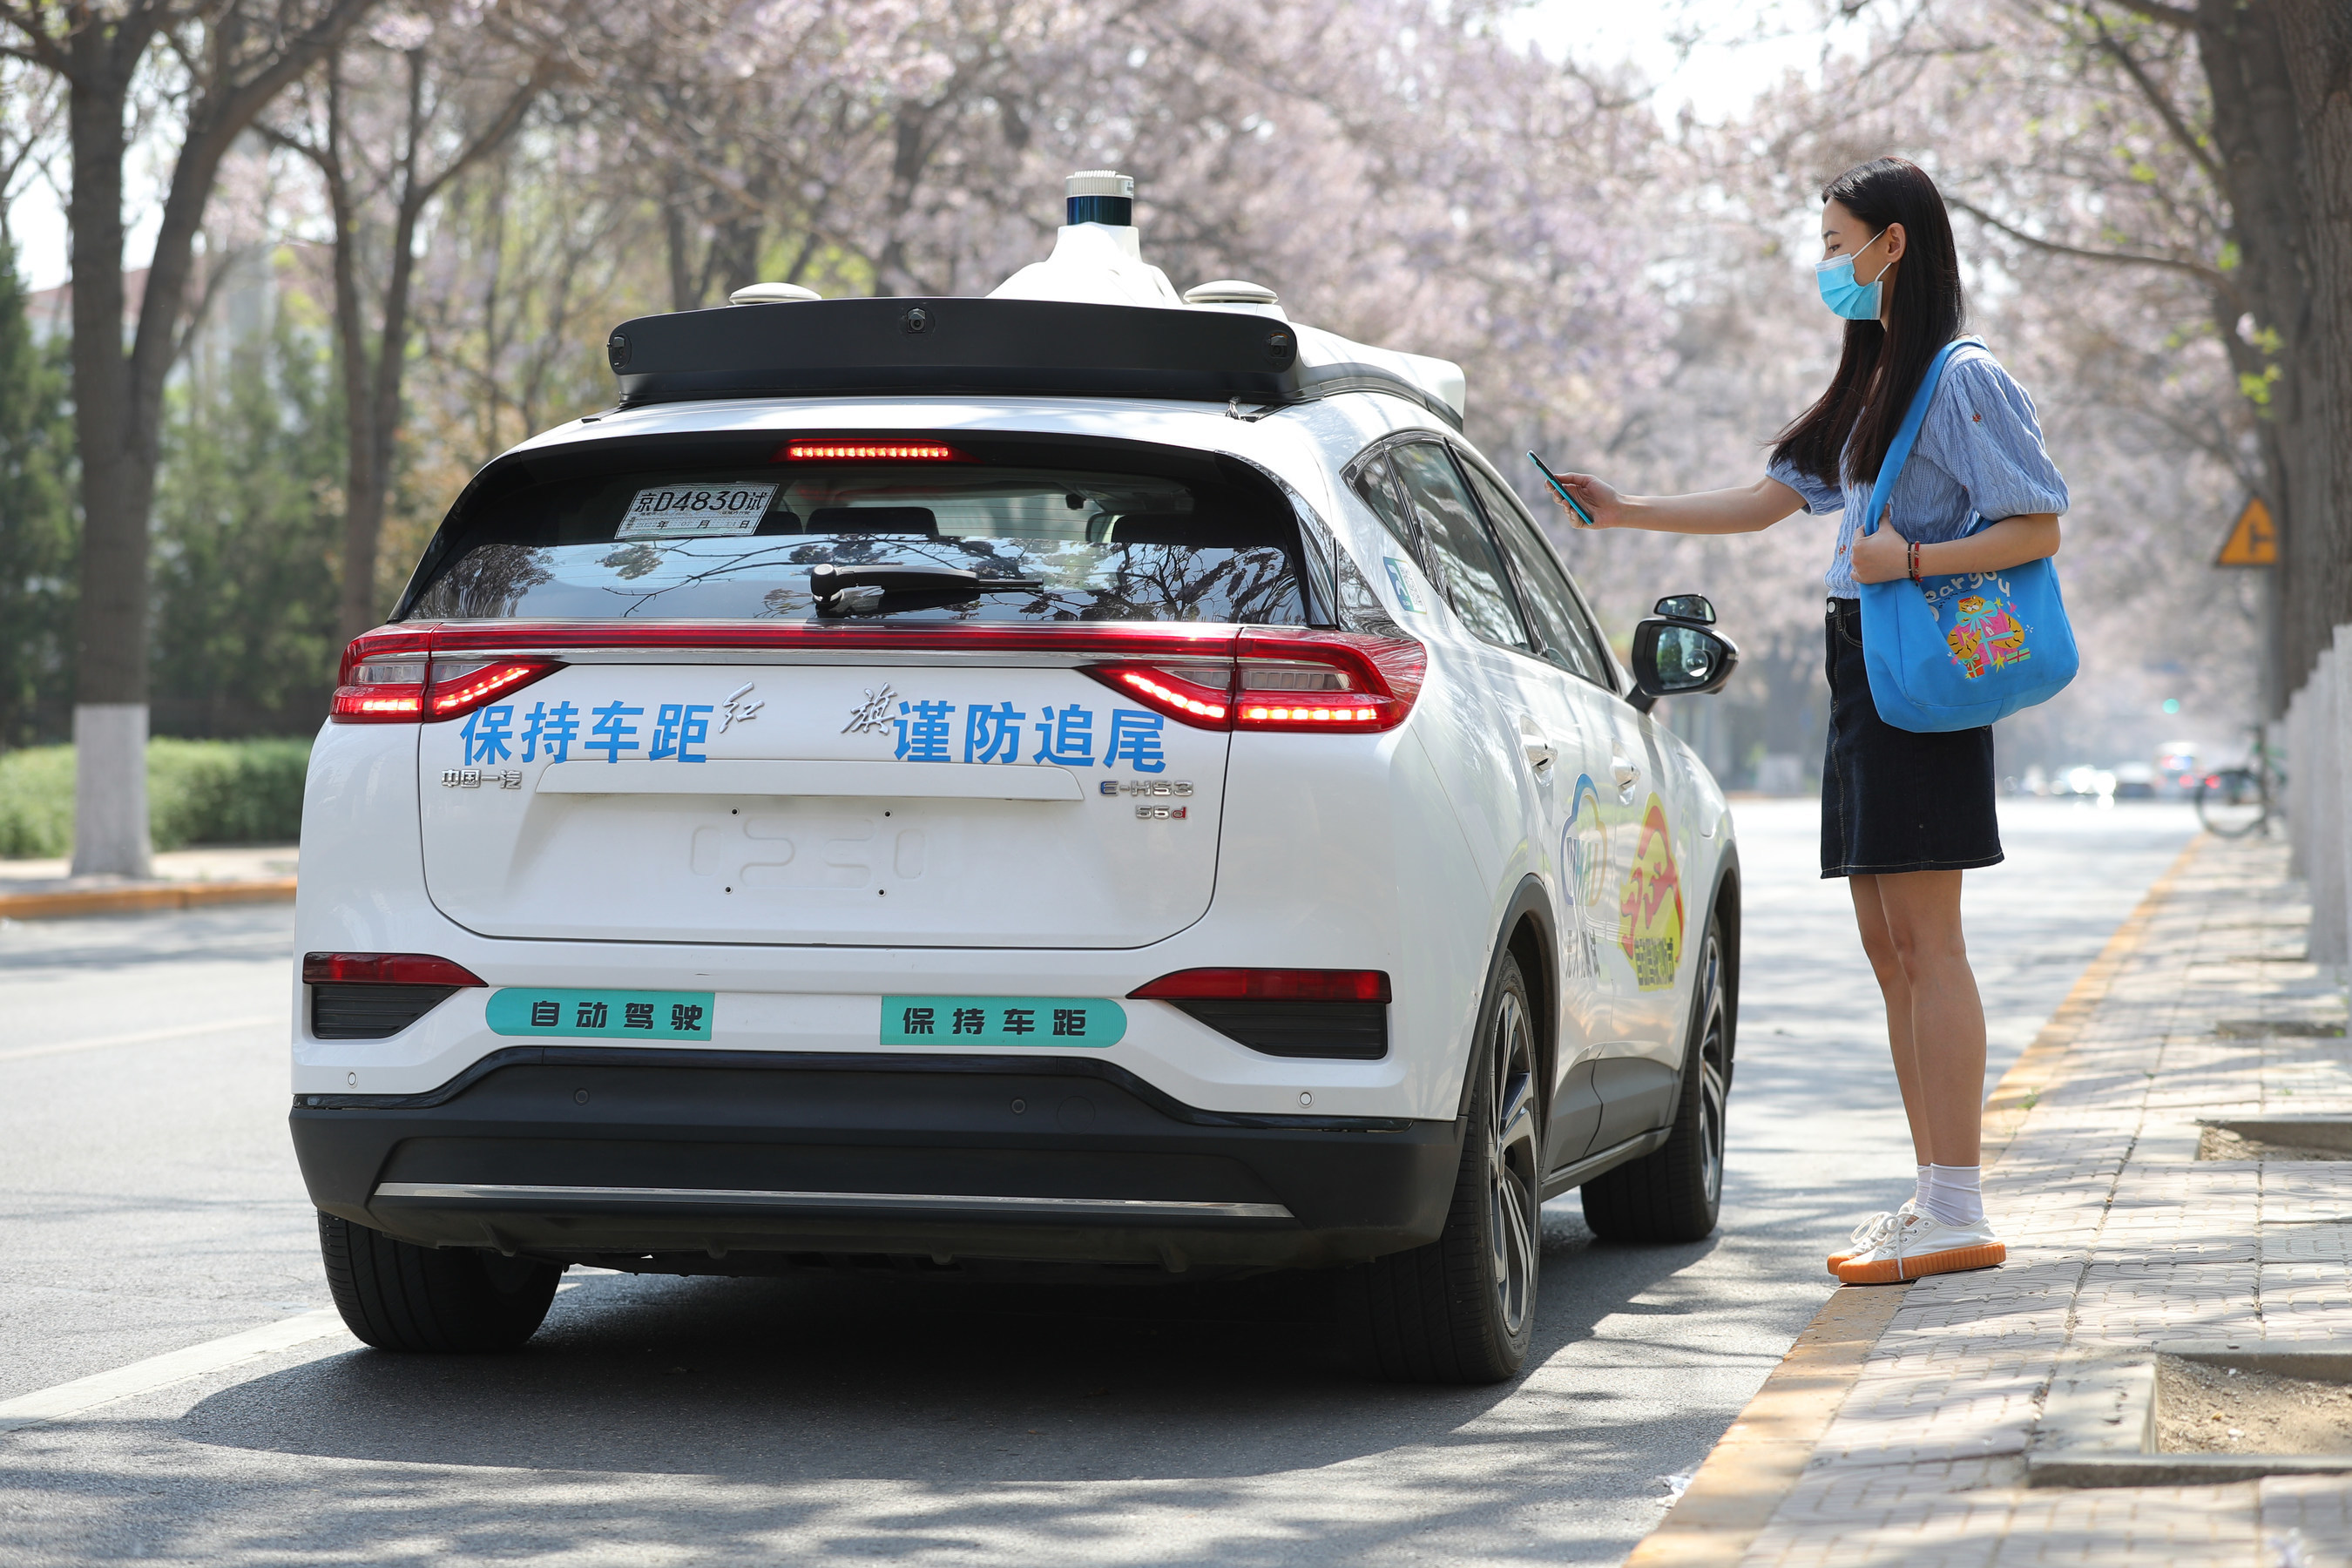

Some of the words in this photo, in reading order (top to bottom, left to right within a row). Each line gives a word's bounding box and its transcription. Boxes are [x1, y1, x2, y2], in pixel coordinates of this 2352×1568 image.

[634, 491, 767, 512] 京D4830试
[657, 521, 669, 530] 年
[697, 520, 710, 529] 月
[460, 700, 713, 766] 保持车距
[893, 700, 1166, 774] 谨防追尾
[442, 769, 522, 789] 中国一汽
[1099, 780, 1193, 796] E-HS3
[1135, 806, 1186, 820] 55d
[531, 1001, 702, 1031] 自动驾驶
[902, 1008, 1086, 1036] 保持车距
